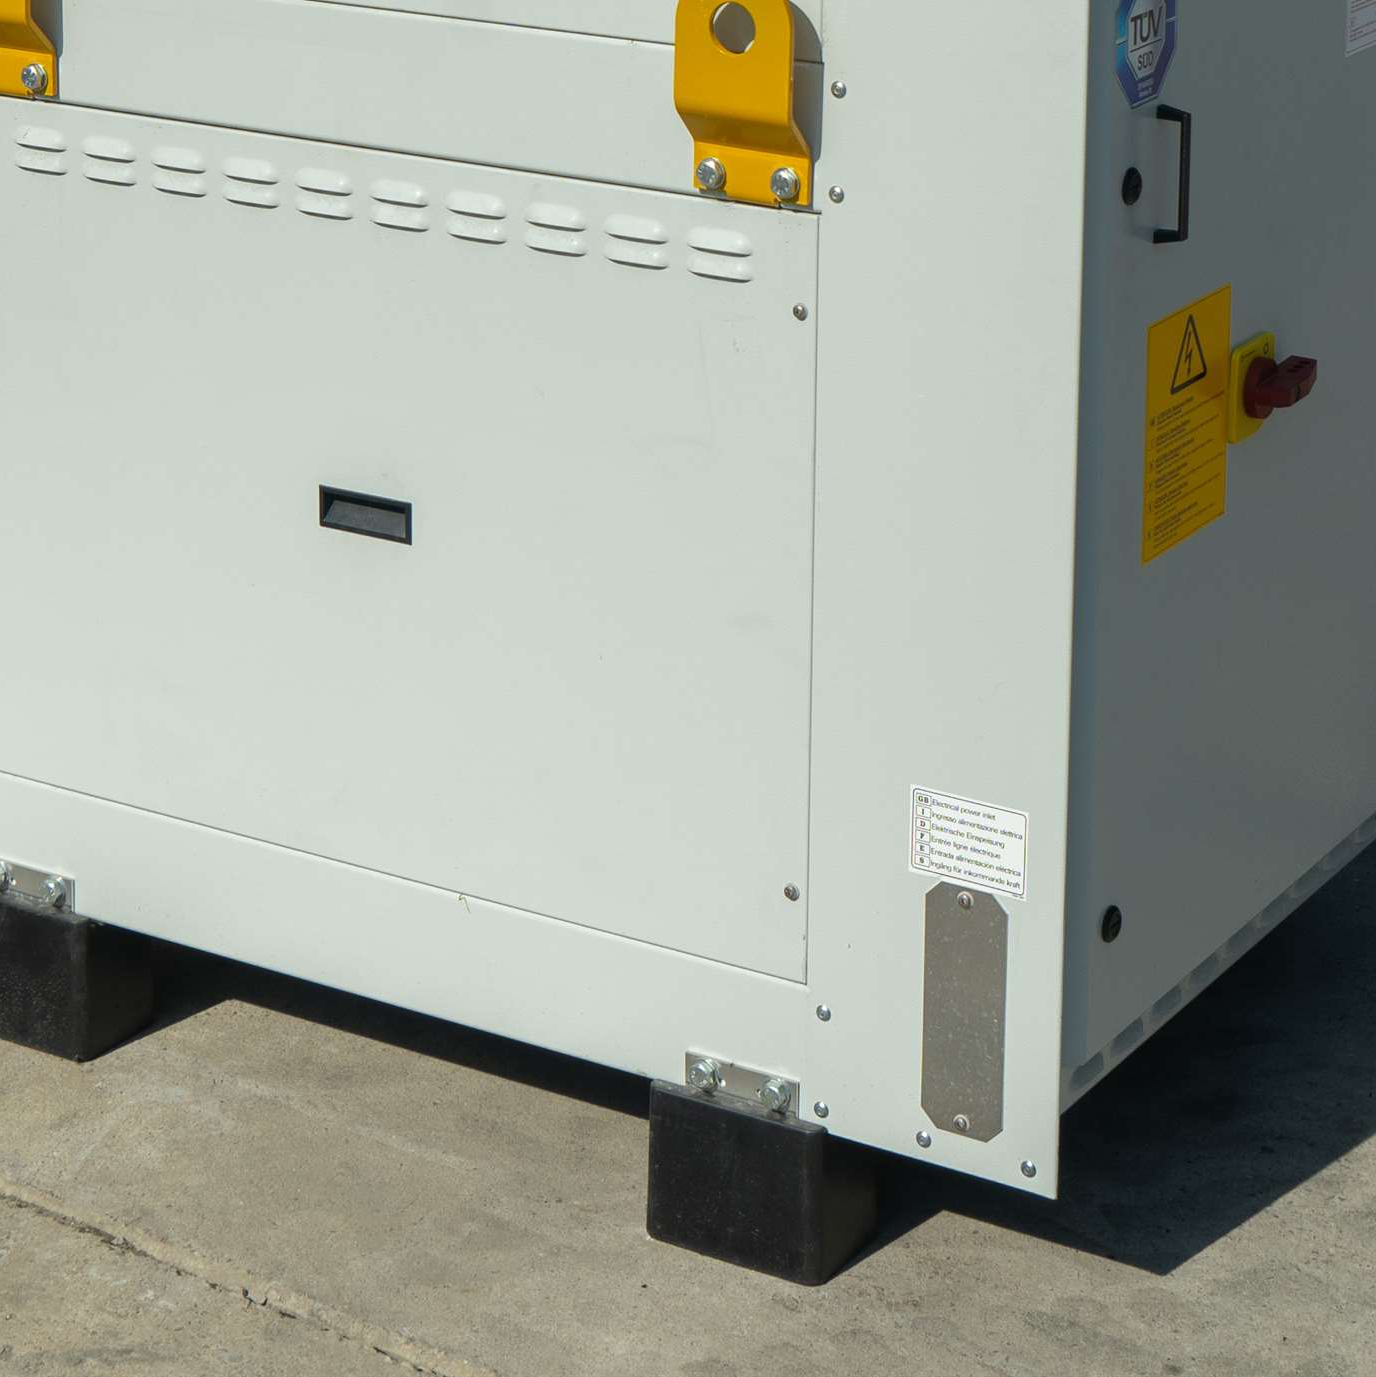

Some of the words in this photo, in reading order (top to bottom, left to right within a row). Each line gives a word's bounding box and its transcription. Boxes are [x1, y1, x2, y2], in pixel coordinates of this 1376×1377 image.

[1130, 6, 1163, 45] TÜV
[918, 795, 929, 804] GB
[932, 799, 959, 812] Electrical
[960, 807, 981, 817] power
